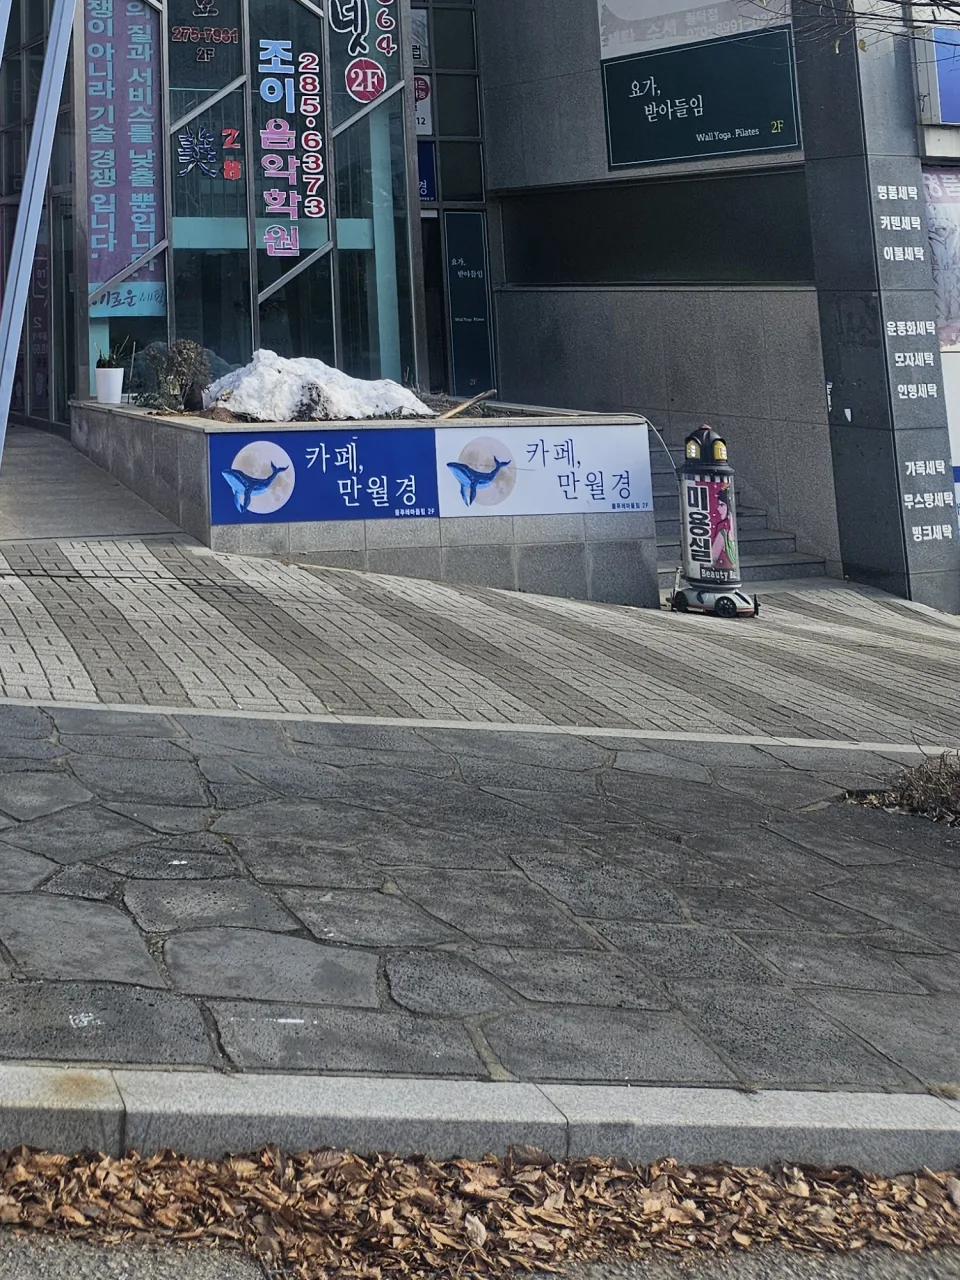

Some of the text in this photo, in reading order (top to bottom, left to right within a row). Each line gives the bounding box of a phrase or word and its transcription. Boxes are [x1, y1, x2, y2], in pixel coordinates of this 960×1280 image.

[127, 24, 154, 62] 질과
[196, 47, 215, 62] 2F
[87, 43, 116, 100] 아니라
[350, 68, 382, 92] 2F
[127, 67, 156, 144] 서비스를
[644, 94, 704, 123] 받아들임
[88, 105, 116, 143] 기술
[771, 120, 784, 133] 2F
[696, 132, 714, 142] Wall
[735, 127, 760, 138] Pilates
[258, 39, 301, 257] 조이 음악학원
[90, 149, 117, 188] 경쟁
[128, 149, 156, 188] 낮출
[877, 185, 918, 200] 명품세탁
[880, 216, 921, 230] 커텐세탁
[883, 246, 924, 261] 이불세탁
[886, 321, 936, 336] 운동화세탁
[894, 352, 934, 367] 모자세탁
[897, 383, 937, 399] 인형세탁
[905, 460, 945, 476] 가죽세탁
[337, 474, 416, 507] 만월경
[557, 470, 631, 501] 만월경
[904, 491, 954, 509] 무스탕세탁
[687, 485, 712, 564] 미용실
[912, 524, 952, 542] 밍크세탁
[701, 568, 728, 581] Beauty
